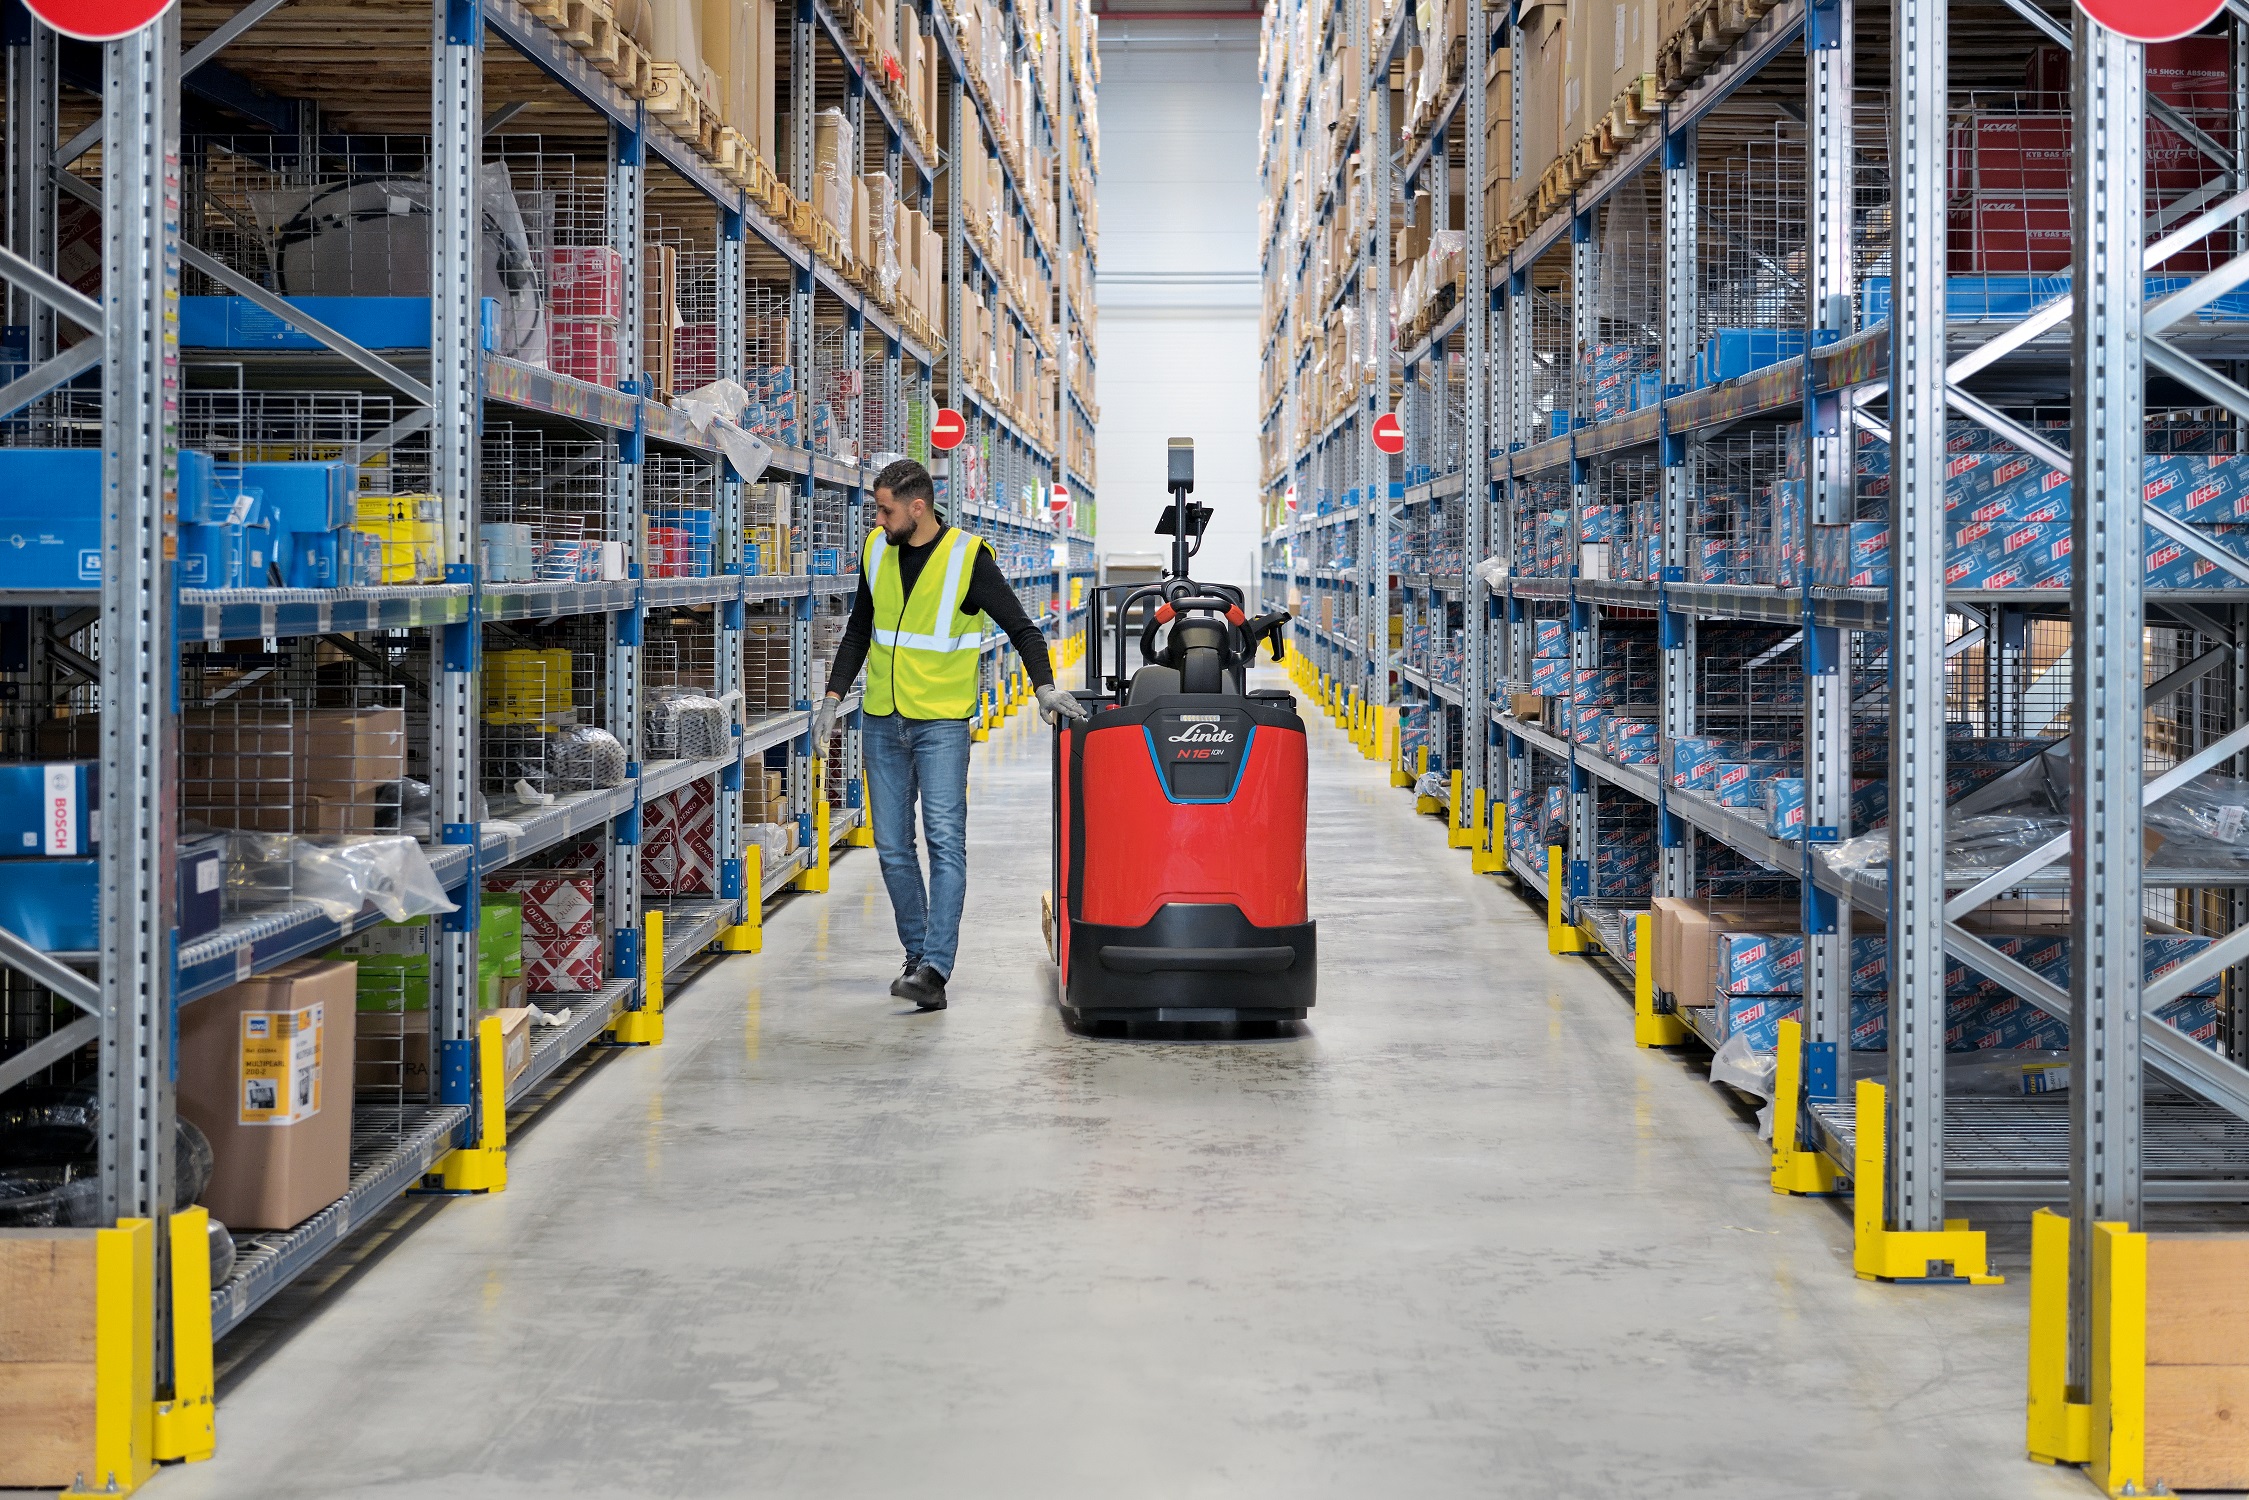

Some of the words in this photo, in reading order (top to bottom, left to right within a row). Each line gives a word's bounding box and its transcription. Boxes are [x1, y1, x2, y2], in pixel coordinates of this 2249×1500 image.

[2187, 70, 2226, 78] ABSORBER
[1168, 722, 1234, 743] Linde
[54, 798, 67, 849] BOSCH
[695, 842, 714, 862] DENSO
[640, 863, 661, 885] DENSO
[526, 907, 555, 934] DENSO
